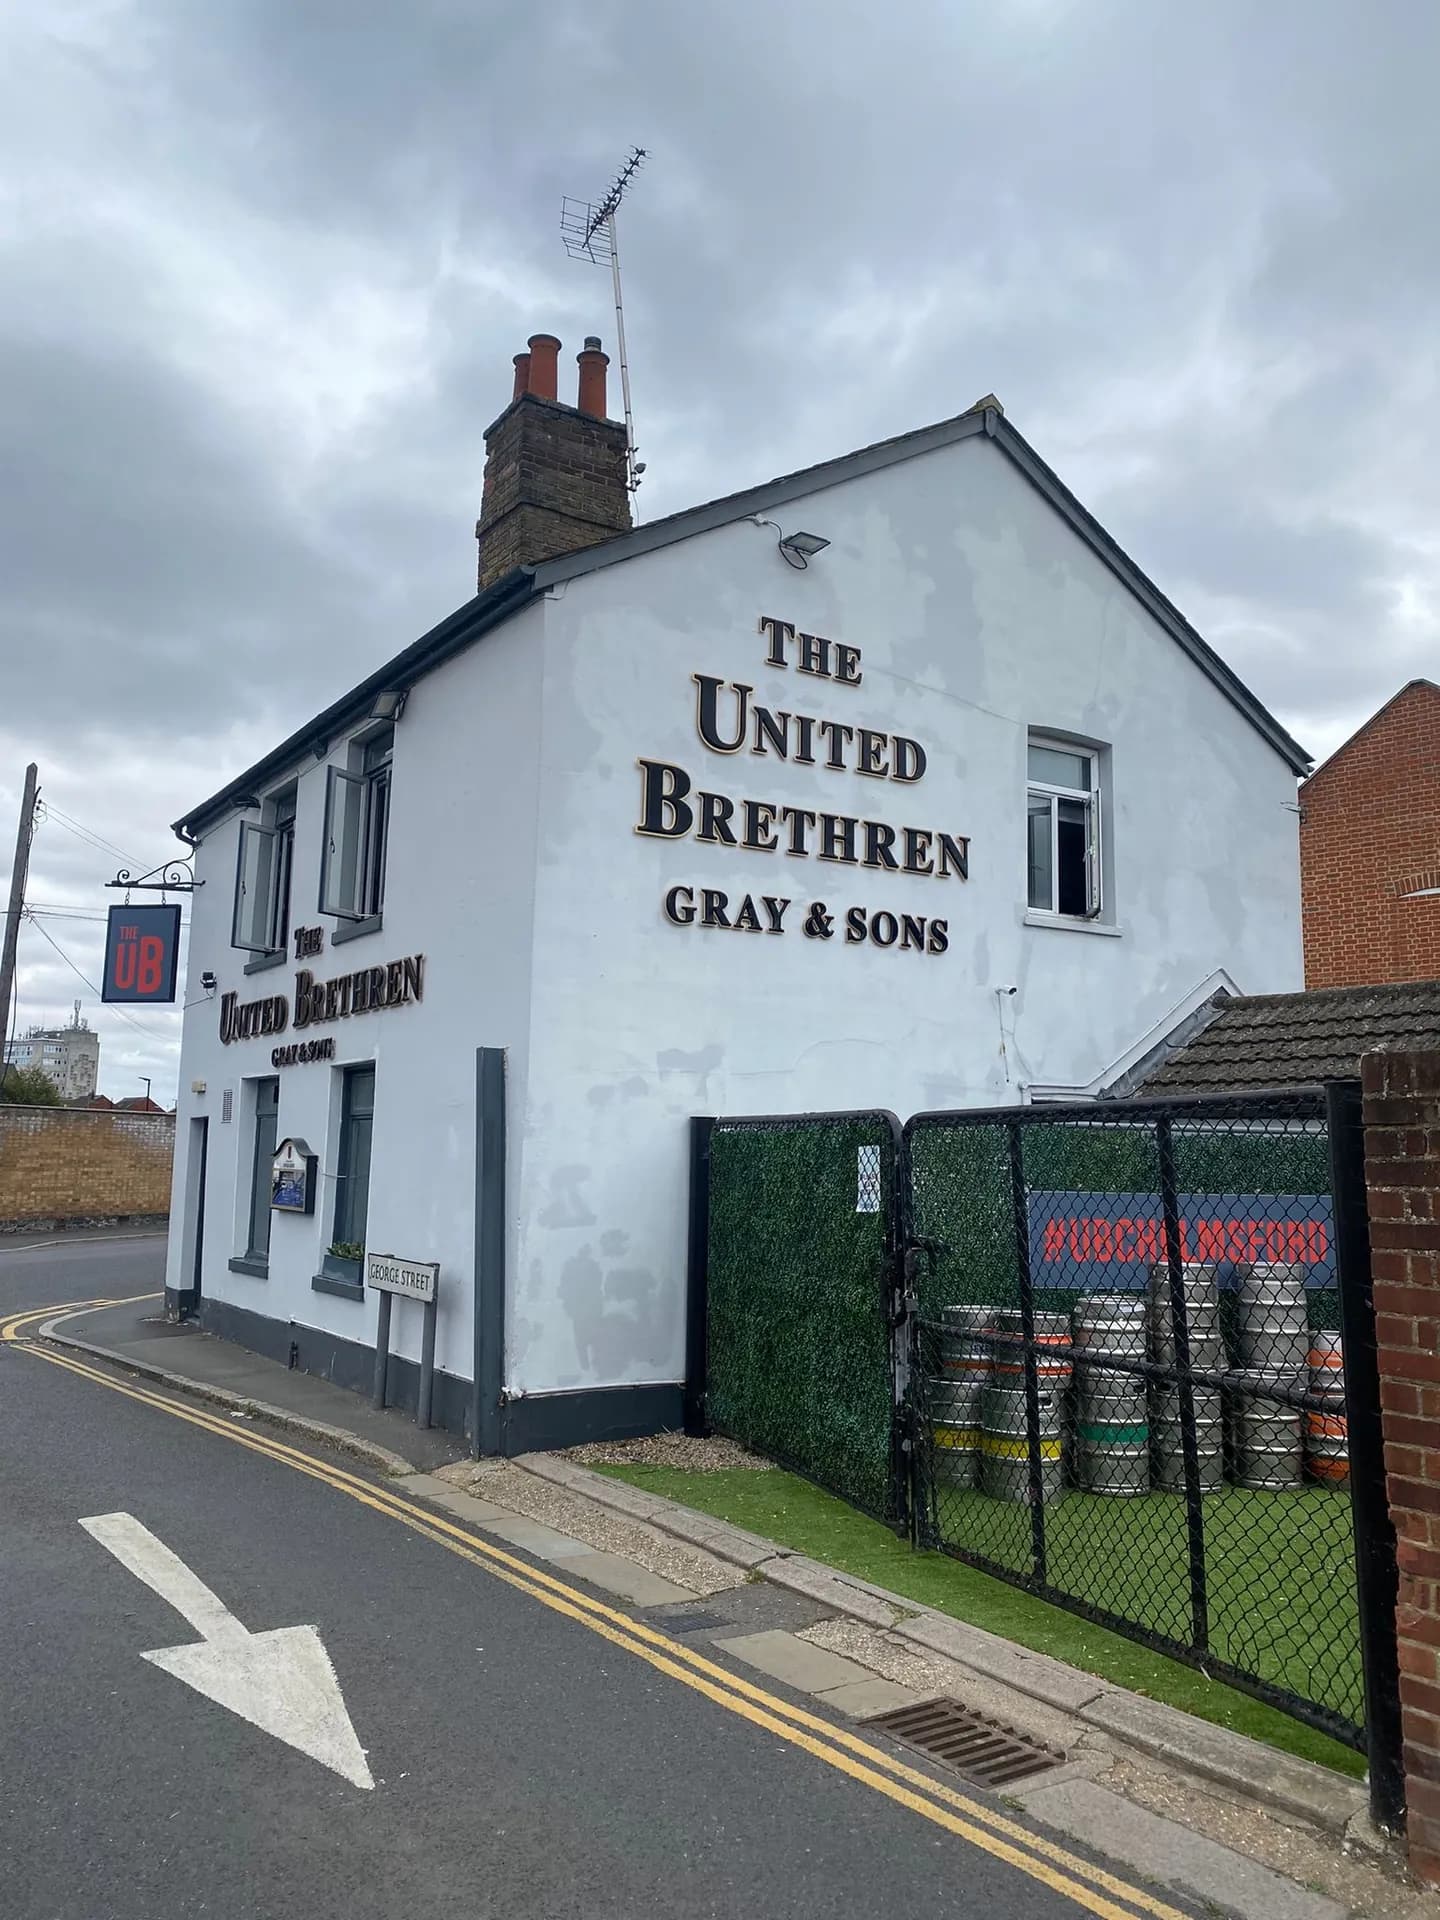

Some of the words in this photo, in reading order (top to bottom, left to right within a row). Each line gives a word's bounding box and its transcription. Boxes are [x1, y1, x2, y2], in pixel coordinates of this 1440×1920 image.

[761, 616, 864, 687] THE
[692, 673, 928, 783] UNITED
[634, 757, 972, 881] BRETHREN
[120, 926, 138, 939] THE
[294, 926, 323, 959] THE
[664, 884, 793, 934] GRAY
[803, 901, 835, 939] &
[846, 906, 950, 955] SONS
[115, 936, 163, 993] UB
[220, 990, 289, 1045] UNITED
[292, 953, 425, 1030] BRETHREN
[370, 1263, 399, 1284] GEORGE
[401, 1270, 430, 1291] STREET
